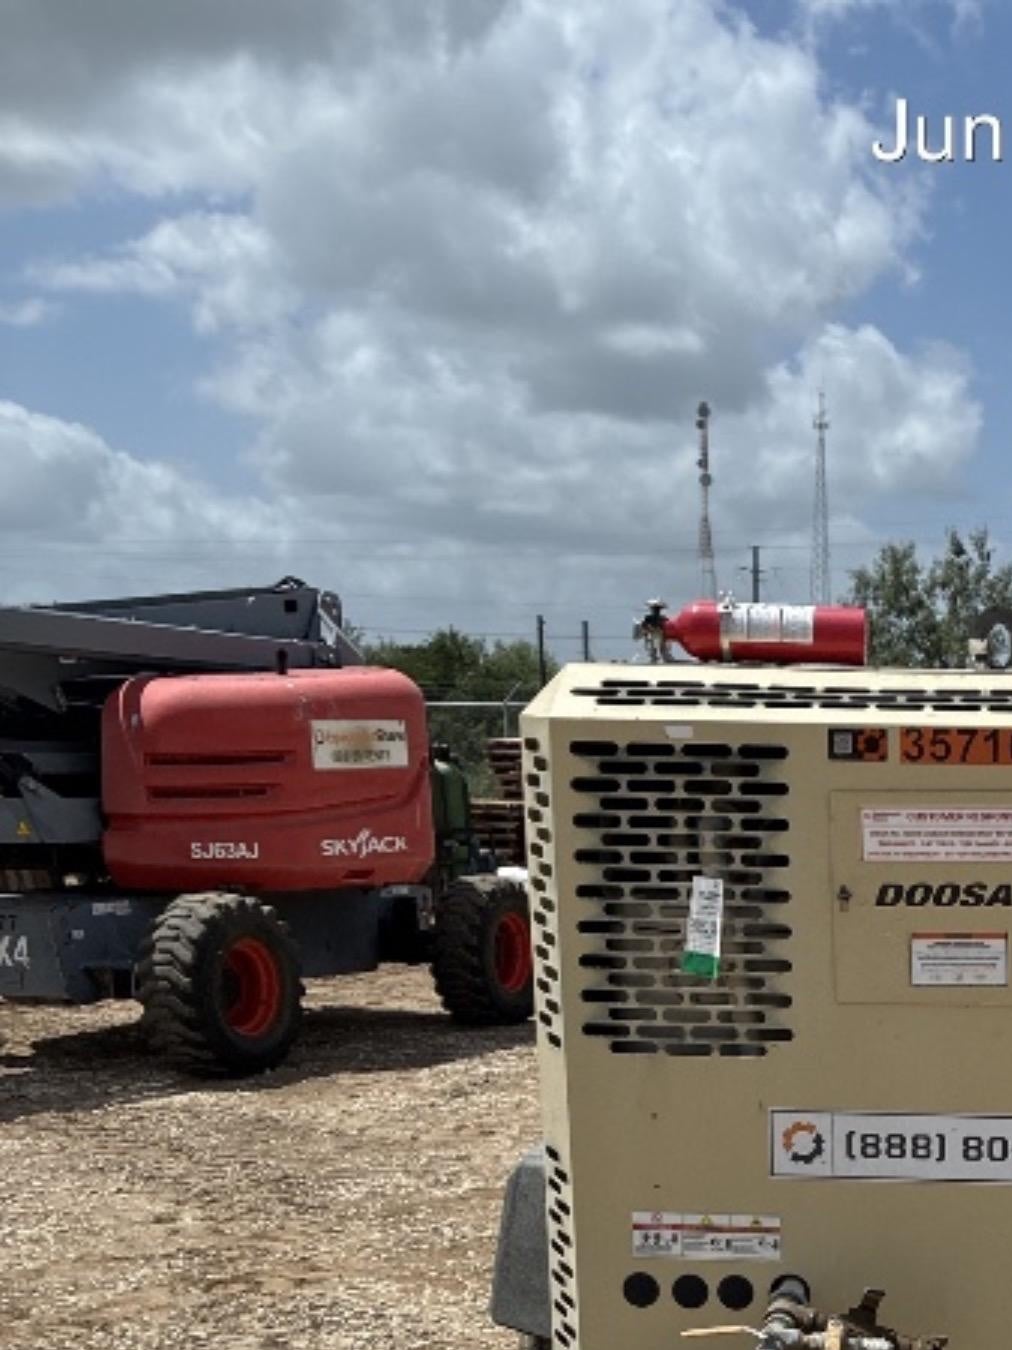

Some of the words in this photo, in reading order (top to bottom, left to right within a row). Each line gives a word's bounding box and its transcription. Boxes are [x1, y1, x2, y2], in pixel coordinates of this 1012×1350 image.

[190, 842, 259, 860] SJ63AJ
[319, 827, 408, 859] SKYJACK
[844, 1130, 947, 1162] (888)
